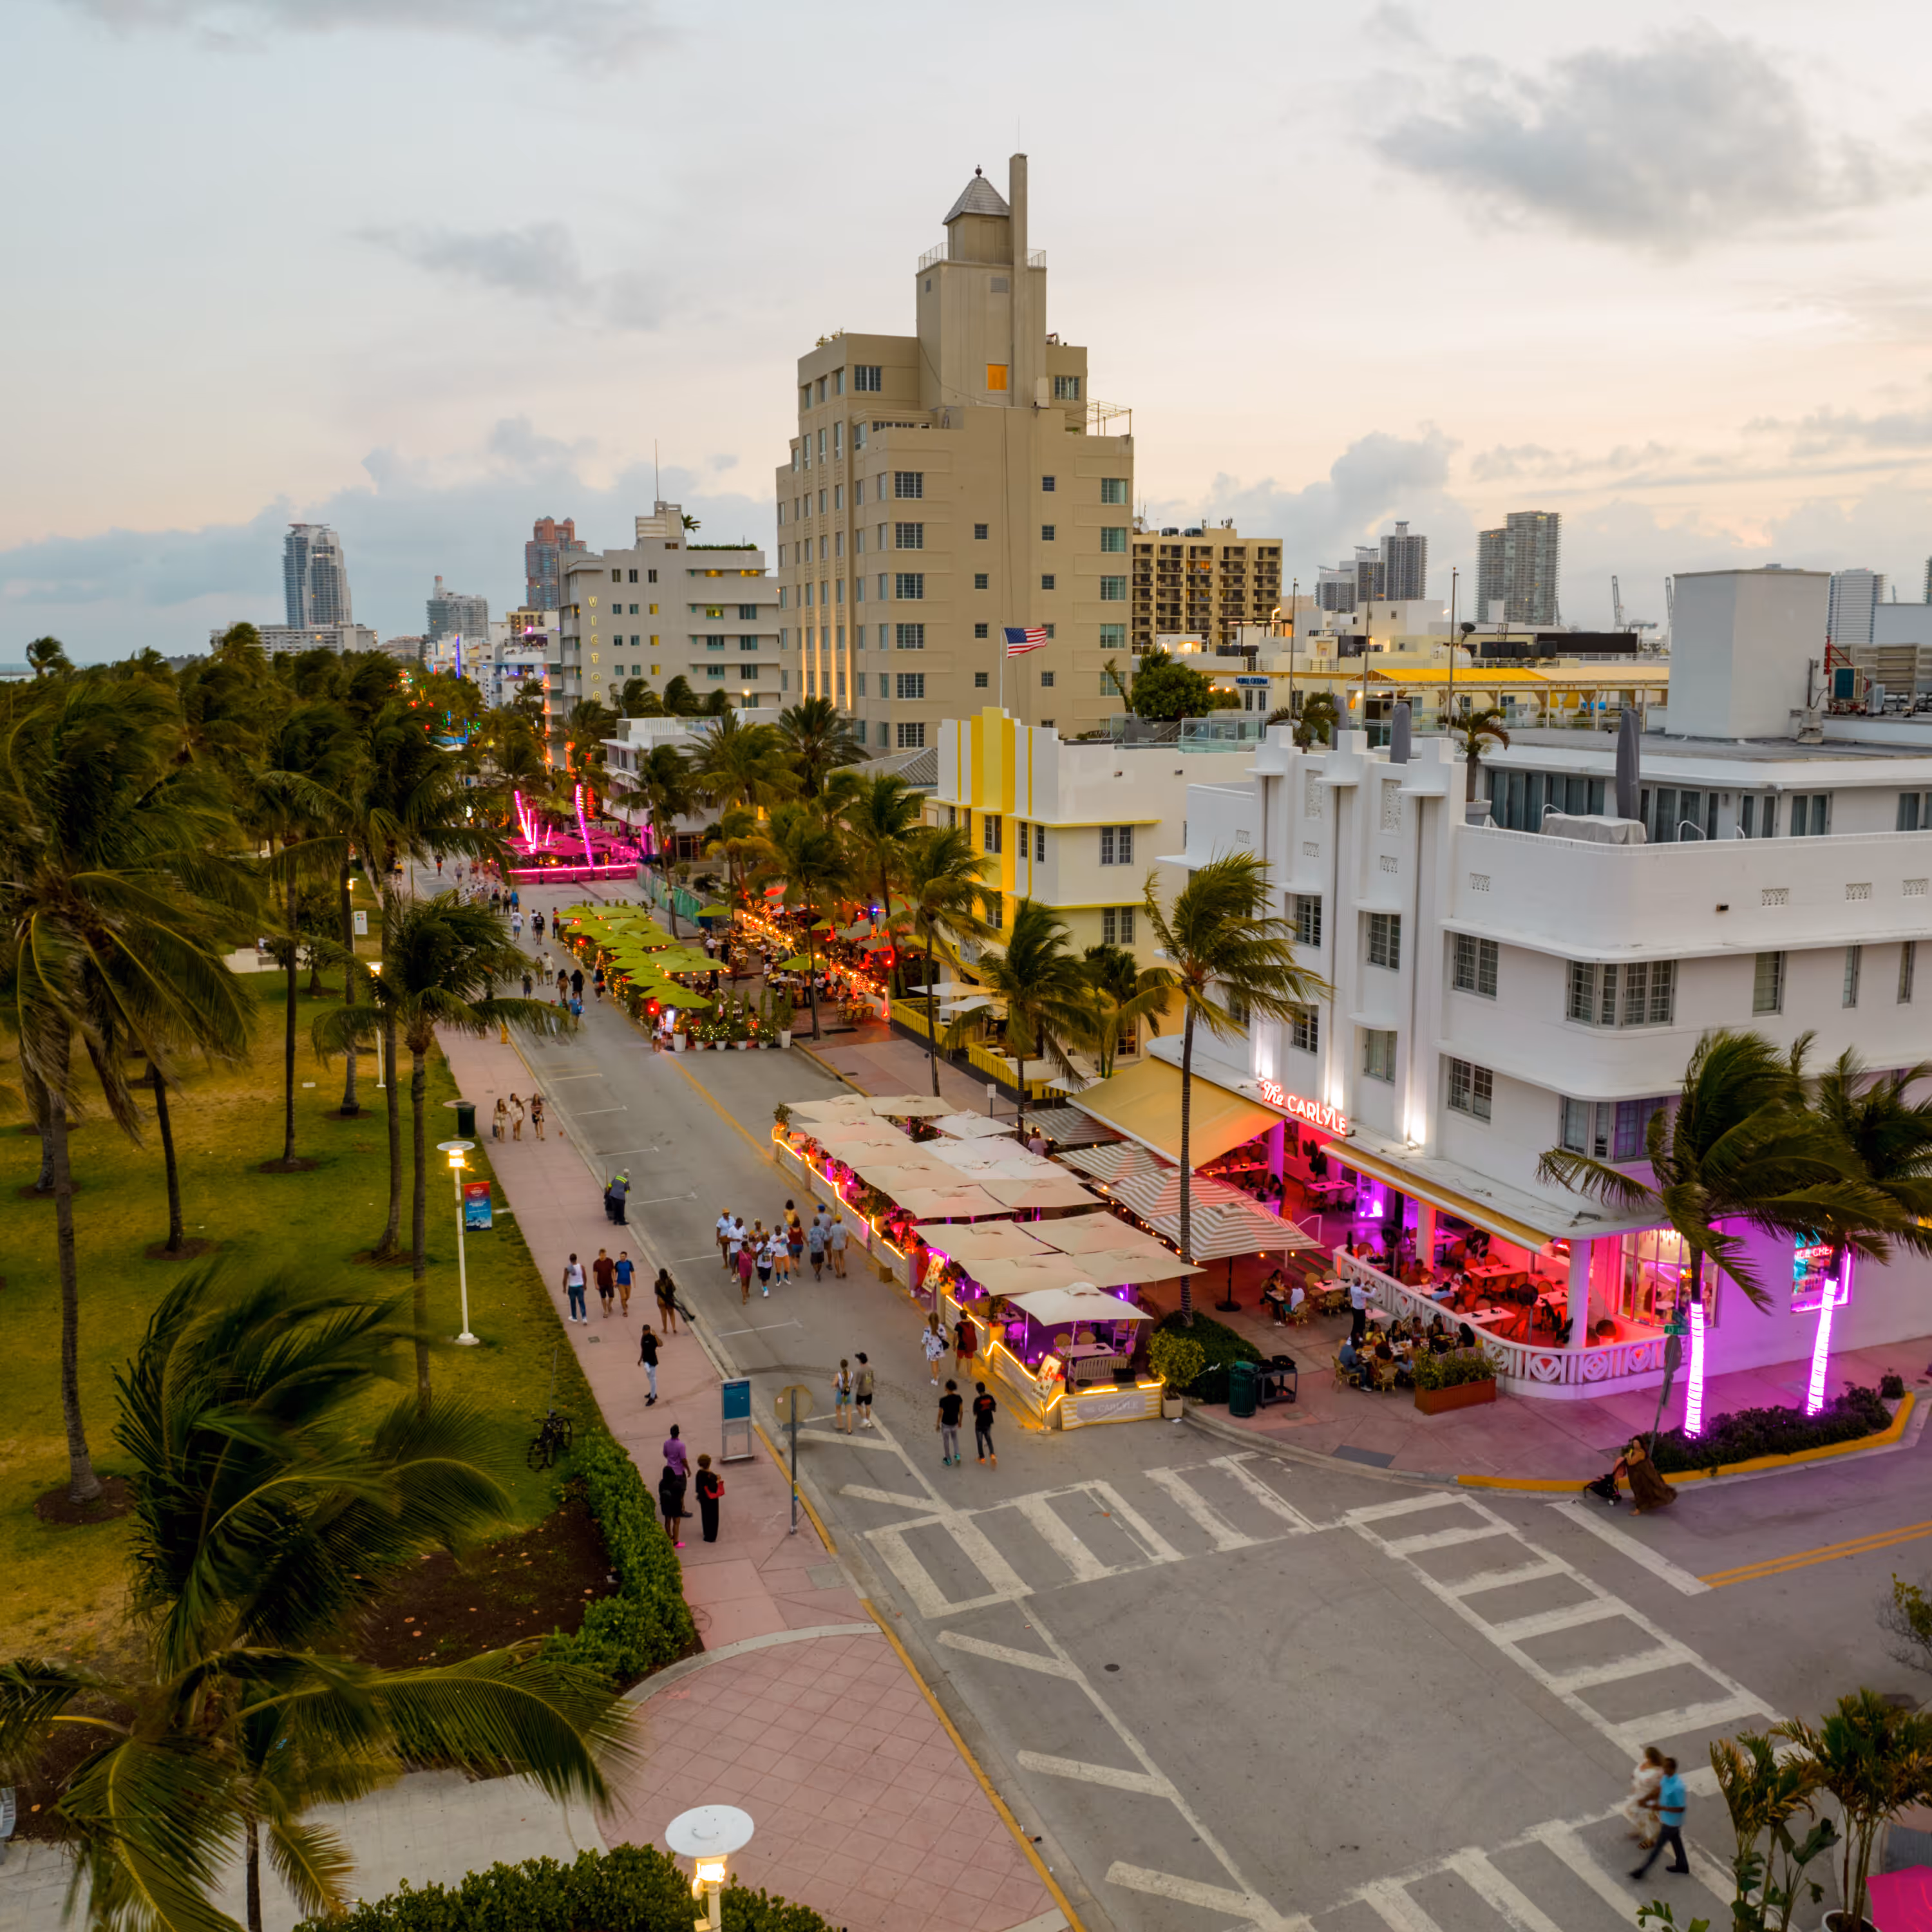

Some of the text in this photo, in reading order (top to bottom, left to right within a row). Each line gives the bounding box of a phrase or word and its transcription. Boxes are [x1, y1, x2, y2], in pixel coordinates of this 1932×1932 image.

[588, 596, 601, 701] VICTOR
[1263, 1080, 1347, 1136] The CARLYLE
